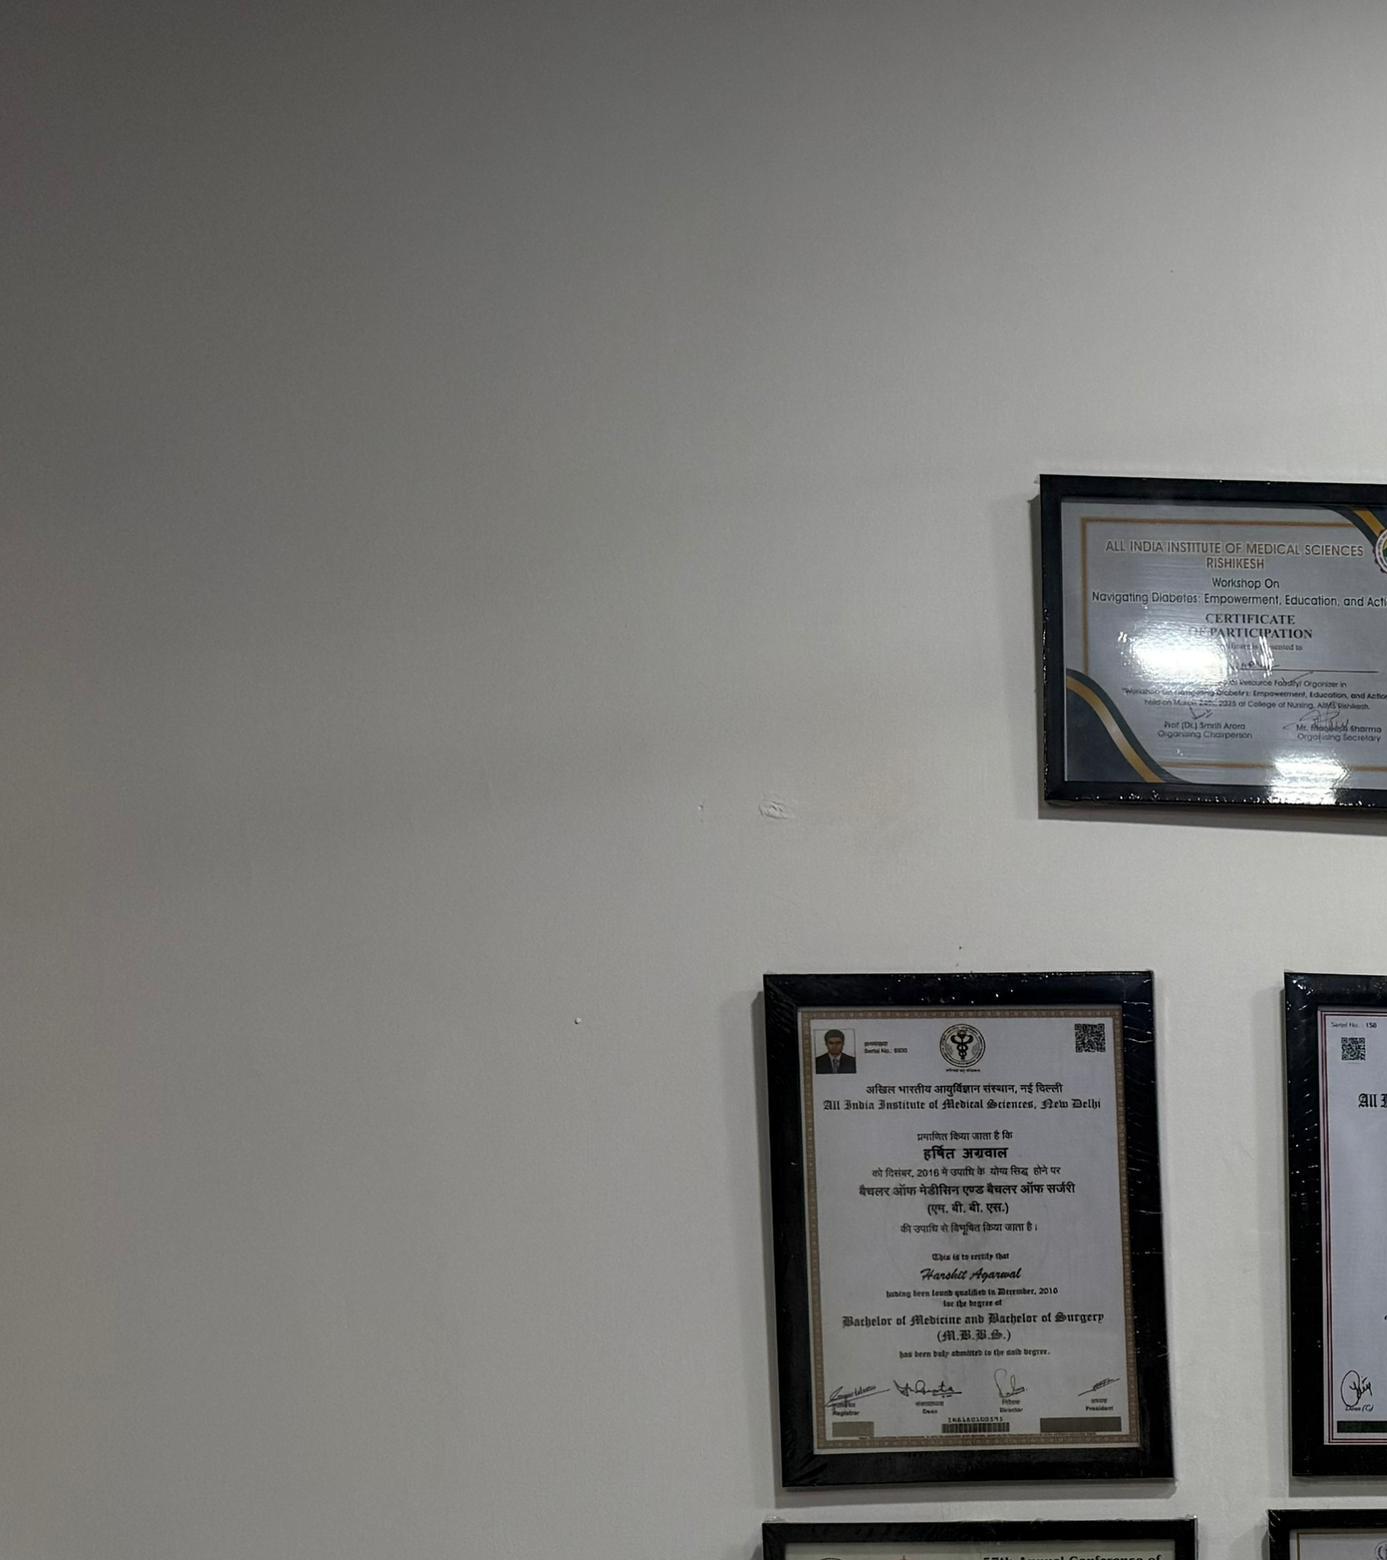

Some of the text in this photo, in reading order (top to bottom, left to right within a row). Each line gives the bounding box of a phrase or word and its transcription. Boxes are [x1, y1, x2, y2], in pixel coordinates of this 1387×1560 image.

[1105, 540, 1363, 557] ALL INDIA INSTITUTE OF MEDICAL SCIENCES
[1206, 557, 1264, 569] RISHIKESH
[1212, 577, 1280, 590] Workshop On
[1092, 591, 1148, 605] Navigating
[1343, 597, 1364, 607] and
[1205, 613, 1295, 625] CERTIFICATE
[1211, 627, 1313, 639] PARTICIPATION
[866, 1083, 896, 1094] अखिल
[898, 1083, 932, 1094] भारतीय
[934, 1082, 981, 1097] आयुर्विज्ञान
[1020, 1082, 1034, 1094] नई
[1035, 1082, 1063, 1093] दिल्ली
[823, 1100, 840, 1110] All
[844, 1099, 875, 1110] India
[878, 1099, 925, 1110] Institute
[929, 1099, 938, 1109] of
[942, 1098, 984, 1110] Medical
[1040, 1098, 1068, 1110] New
[1071, 1098, 1101, 1110] Delhi
[1358, 1093, 1377, 1108] All
[923, 1145, 1009, 1161] हर्षित अग्रवाल
[920, 1267, 1022, 1283] Harshit Agarwal
[937, 1329, 1011, 1343] (M.B.B.S.)
